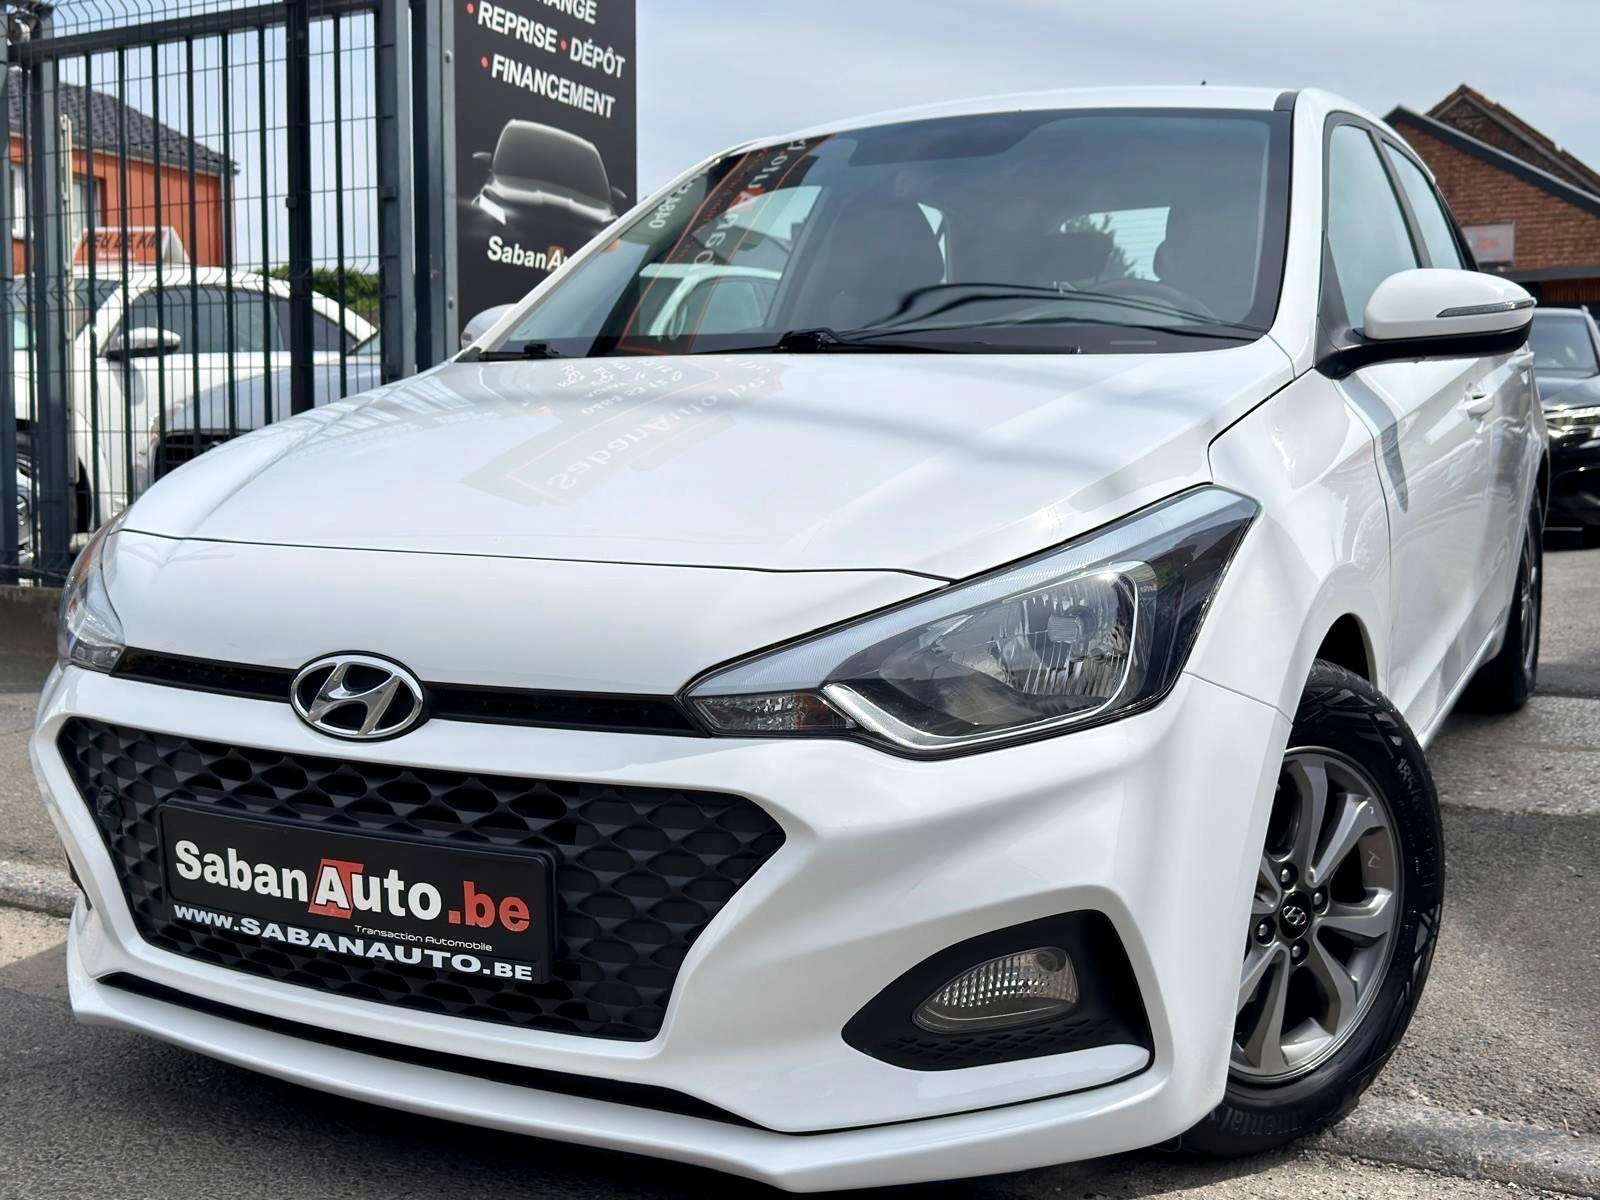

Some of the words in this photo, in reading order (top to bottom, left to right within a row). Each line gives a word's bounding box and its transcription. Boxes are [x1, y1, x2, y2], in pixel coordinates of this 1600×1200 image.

[477, 0, 558, 53] REPRISE
[569, 36, 626, 79] DÉPÔT
[491, 53, 616, 119] FINANCEMENT
[354, 924, 423, 943] Transaction
[425, 936, 493, 952] Automobile
